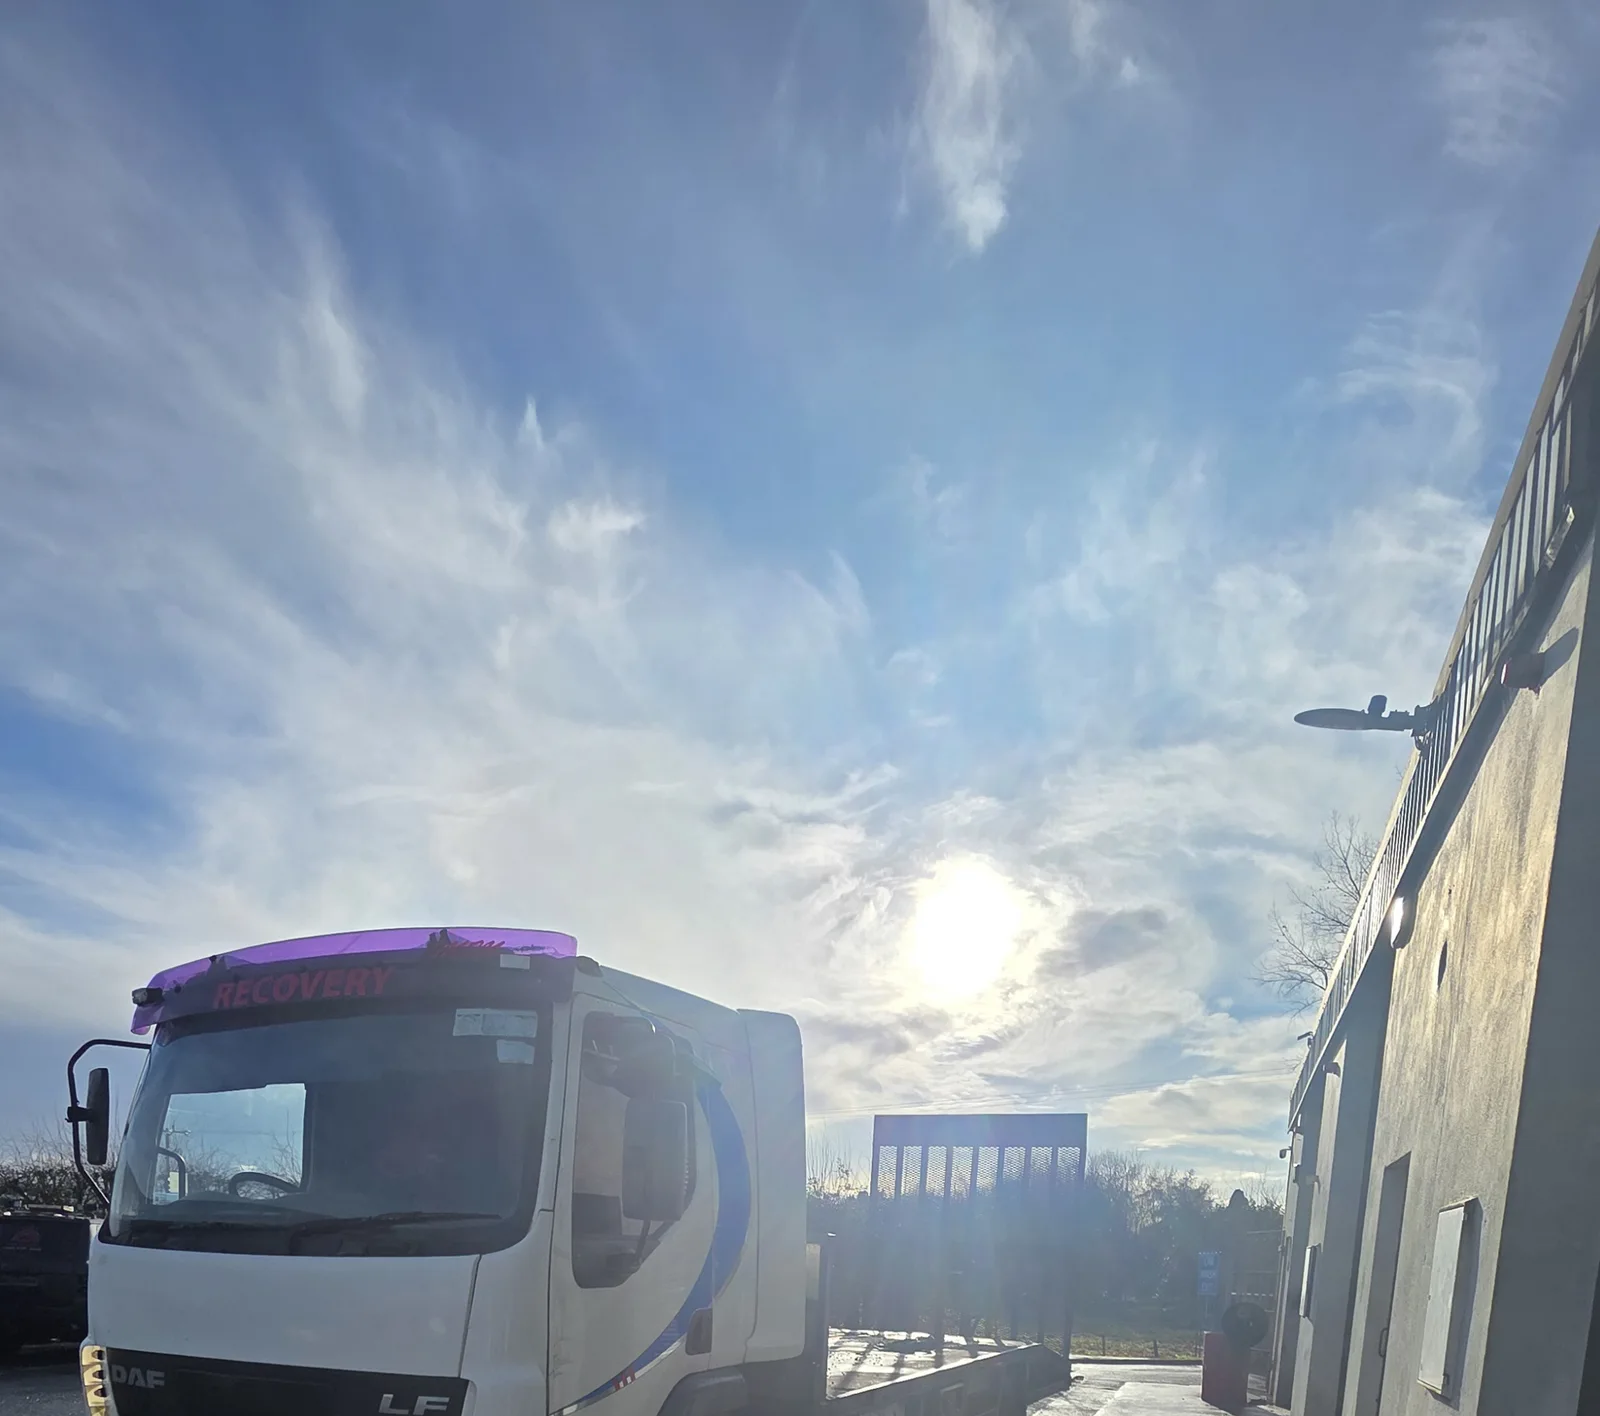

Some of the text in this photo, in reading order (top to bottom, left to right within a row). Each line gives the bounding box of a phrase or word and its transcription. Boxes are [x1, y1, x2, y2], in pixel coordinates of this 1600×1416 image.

[213, 967, 395, 1009] RECOVERY
[111, 1364, 165, 1388] DAF
[379, 1394, 450, 1415] LF
